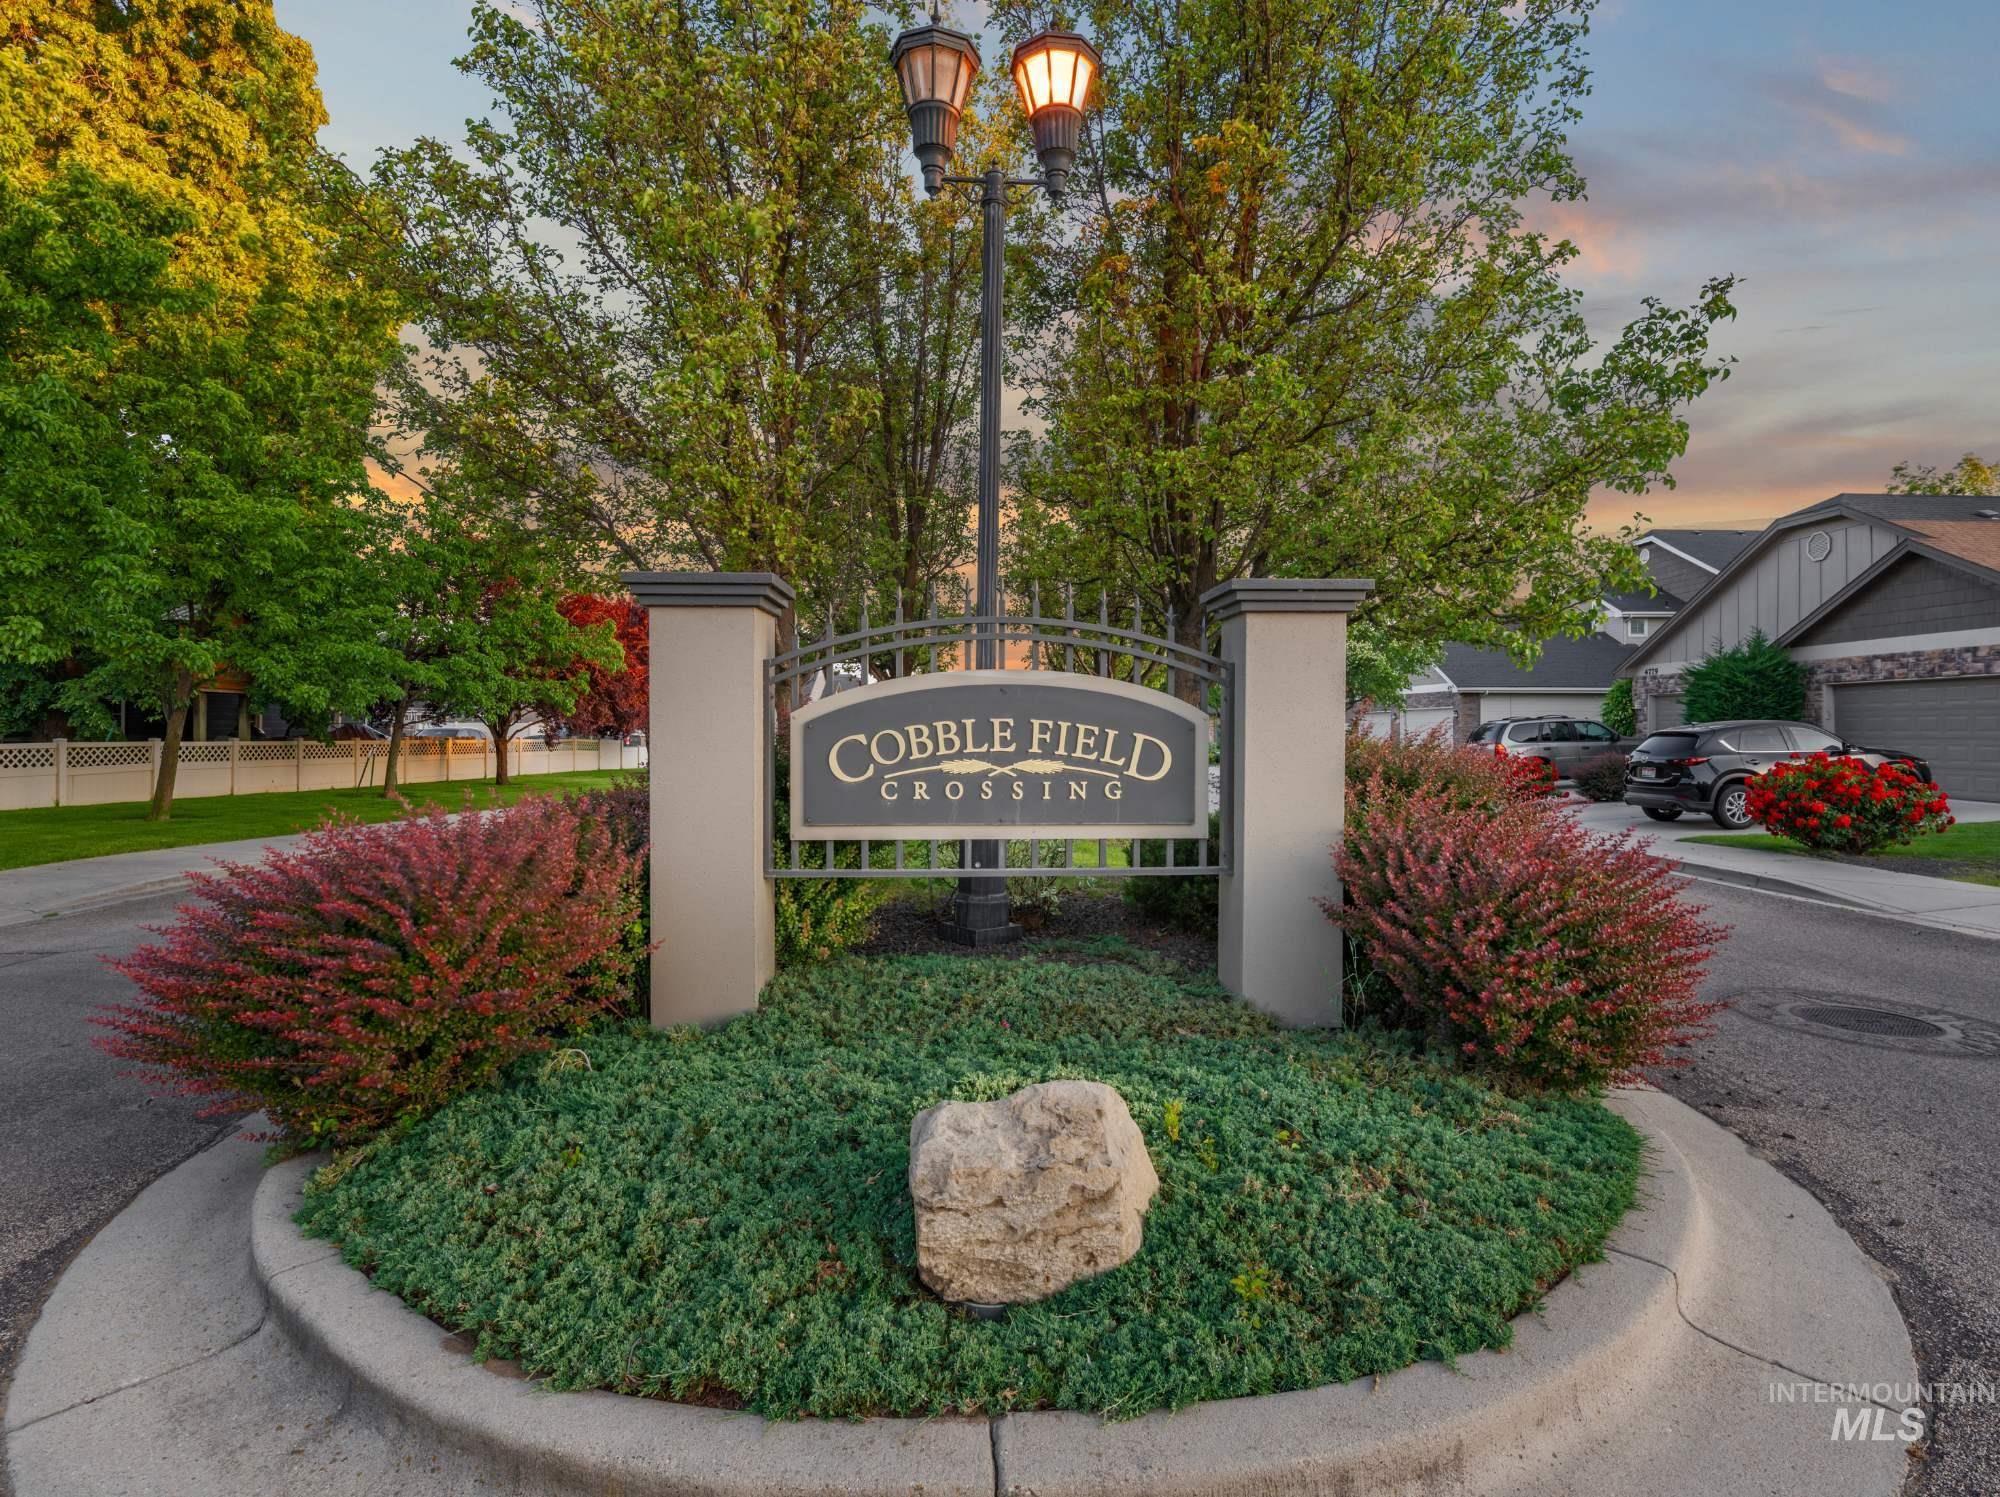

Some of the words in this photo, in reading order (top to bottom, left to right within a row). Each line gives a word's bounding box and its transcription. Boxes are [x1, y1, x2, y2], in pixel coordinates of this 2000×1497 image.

[828, 718, 1017, 783] COBBLE
[1028, 719, 1173, 781] FIELD
[880, 781, 1123, 800] CROSSING
